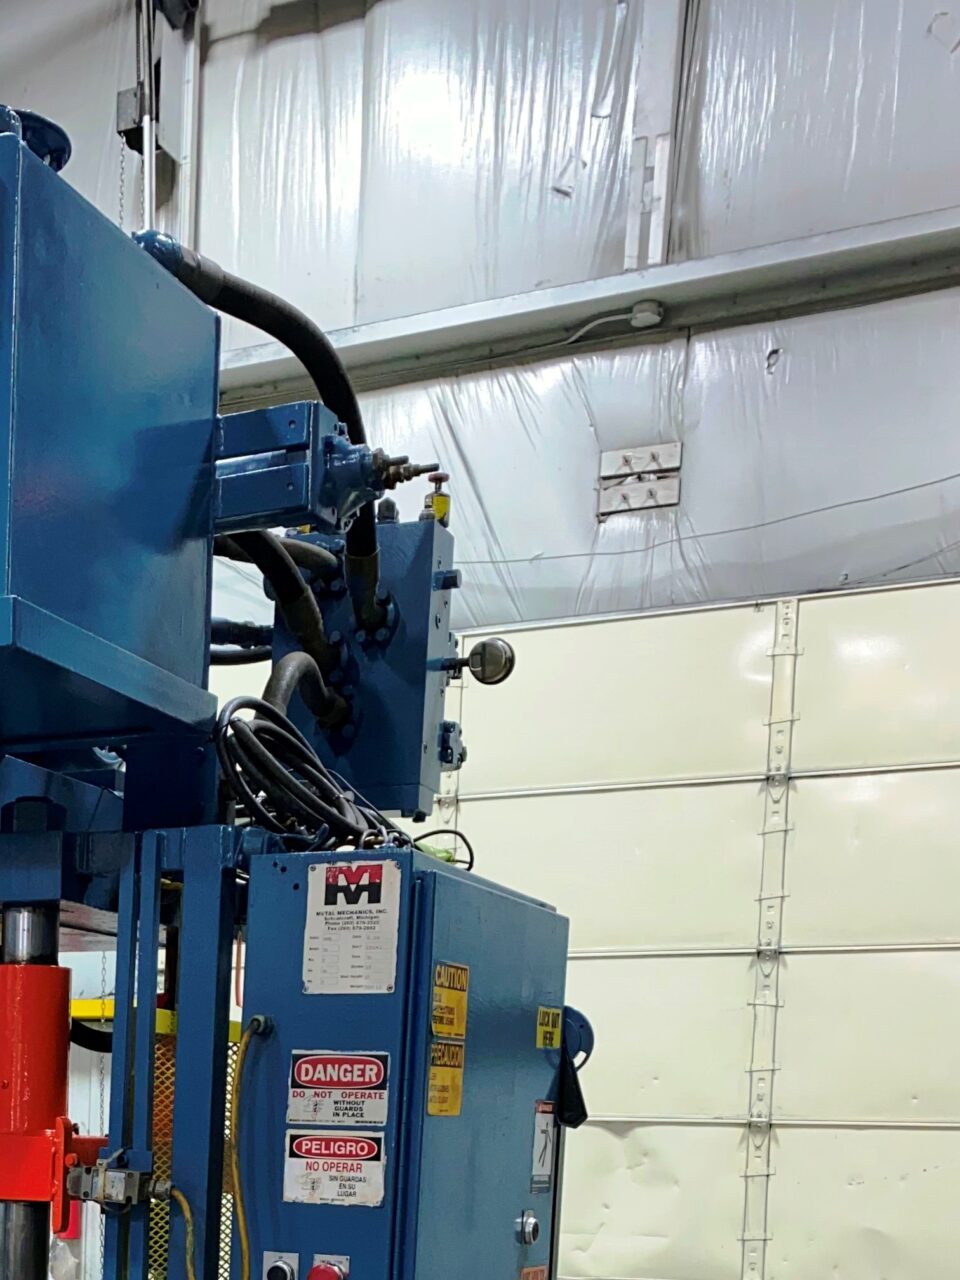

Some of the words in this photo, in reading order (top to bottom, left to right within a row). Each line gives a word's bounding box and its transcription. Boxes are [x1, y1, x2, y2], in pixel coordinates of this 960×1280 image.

[436, 965, 467, 990] CAUTION
[539, 1010, 550, 1027] LOCK
[301, 1063, 378, 1082] DANGER
[292, 1090, 305, 1098] DO
[313, 1091, 333, 1099] NOT
[341, 1091, 385, 1100] OPERATE
[301, 1140, 368, 1155] PELIGRO
[305, 1161, 320, 1172] NO
[322, 1161, 363, 1173] OPERAR
[339, 1175, 367, 1183] GUARDAS
